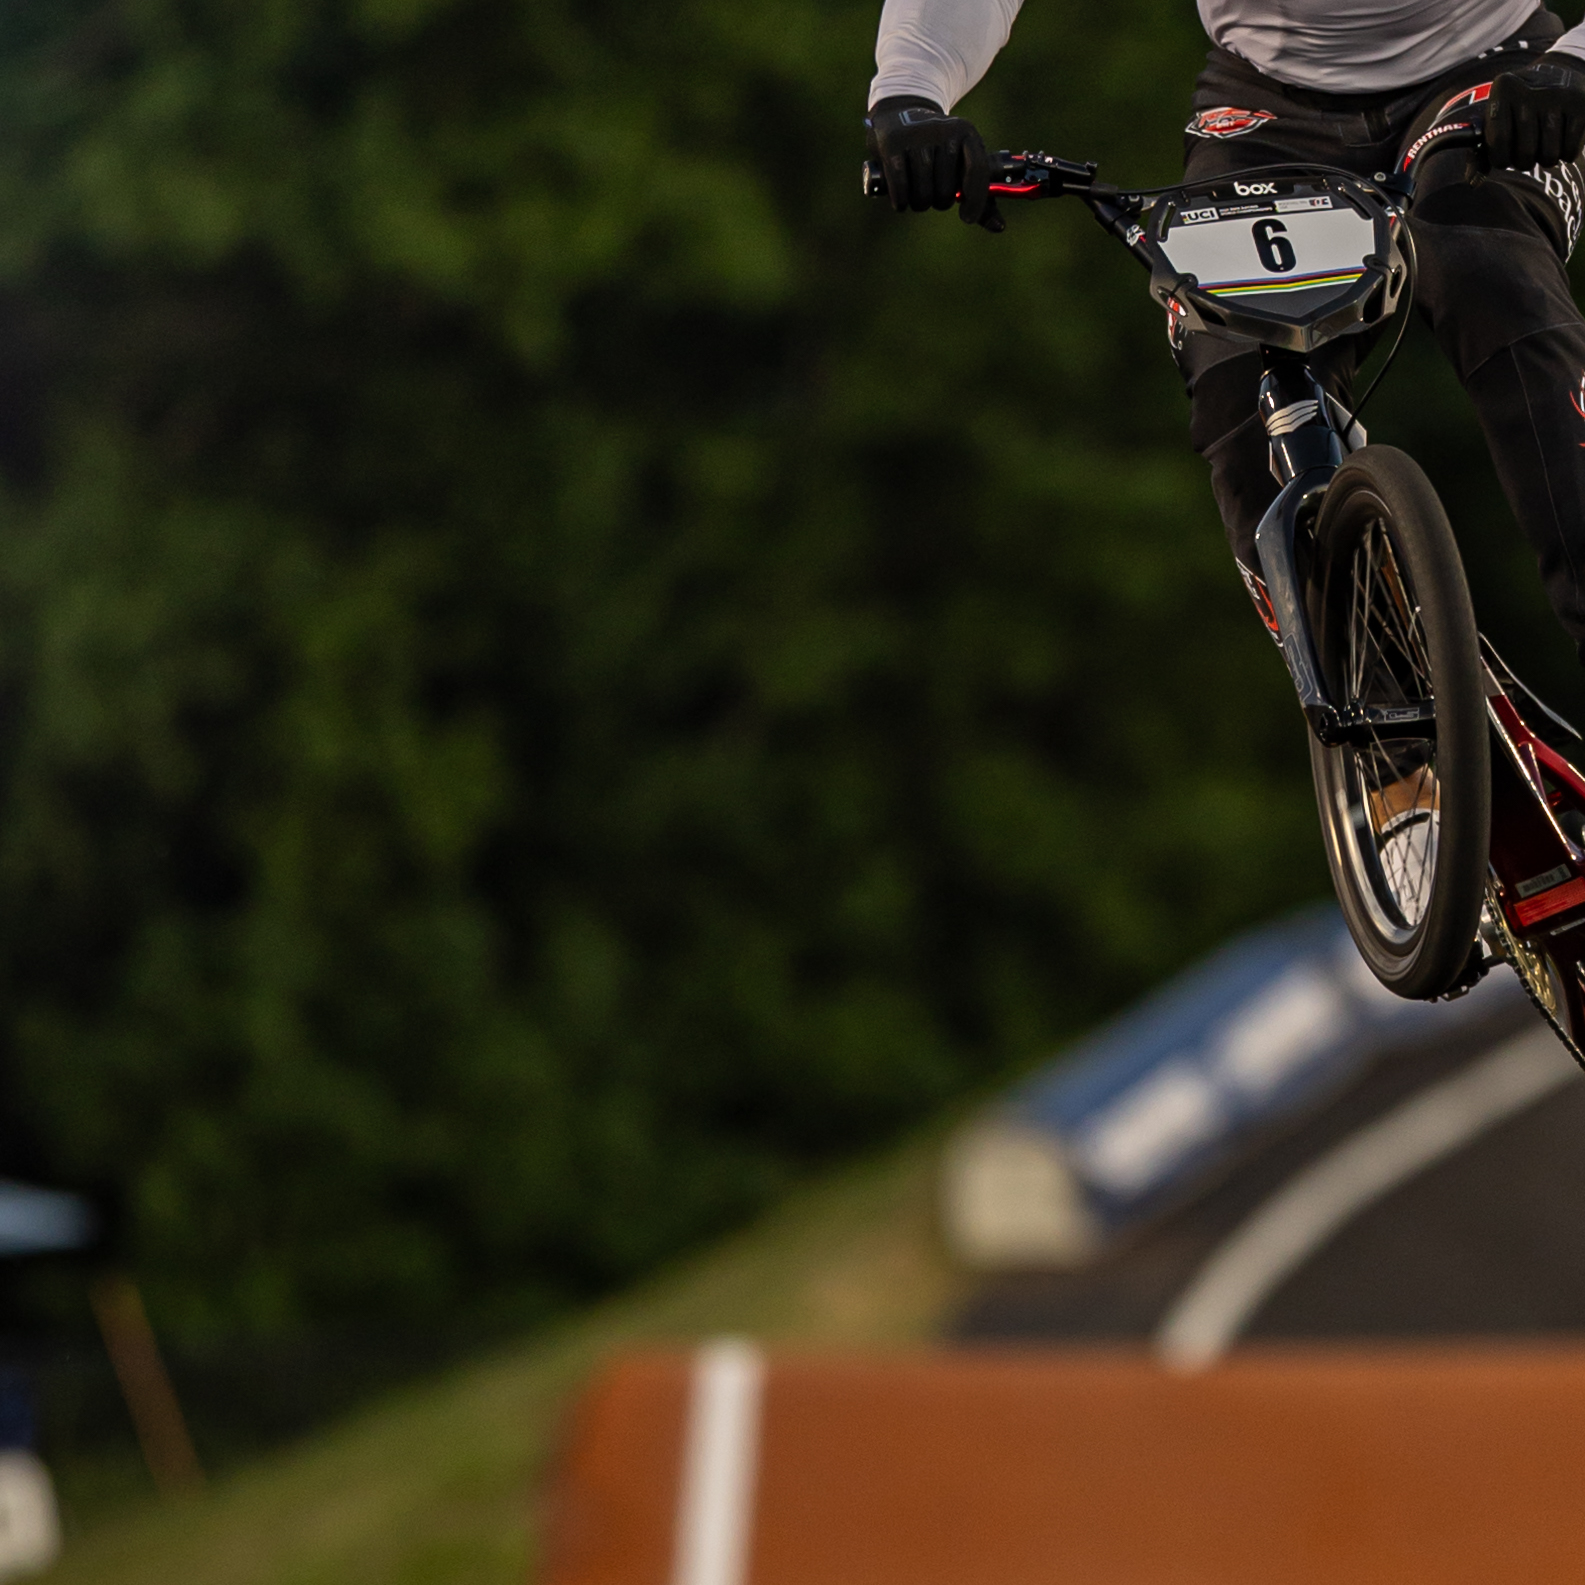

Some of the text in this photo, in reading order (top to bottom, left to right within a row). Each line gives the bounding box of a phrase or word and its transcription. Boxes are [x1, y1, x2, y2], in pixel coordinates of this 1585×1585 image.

[1407, 123, 1464, 160] RENTHAL
[1233, 181, 1278, 196] box
[1187, 209, 1216, 222] UCI
[1251, 218, 1297, 273] 6
